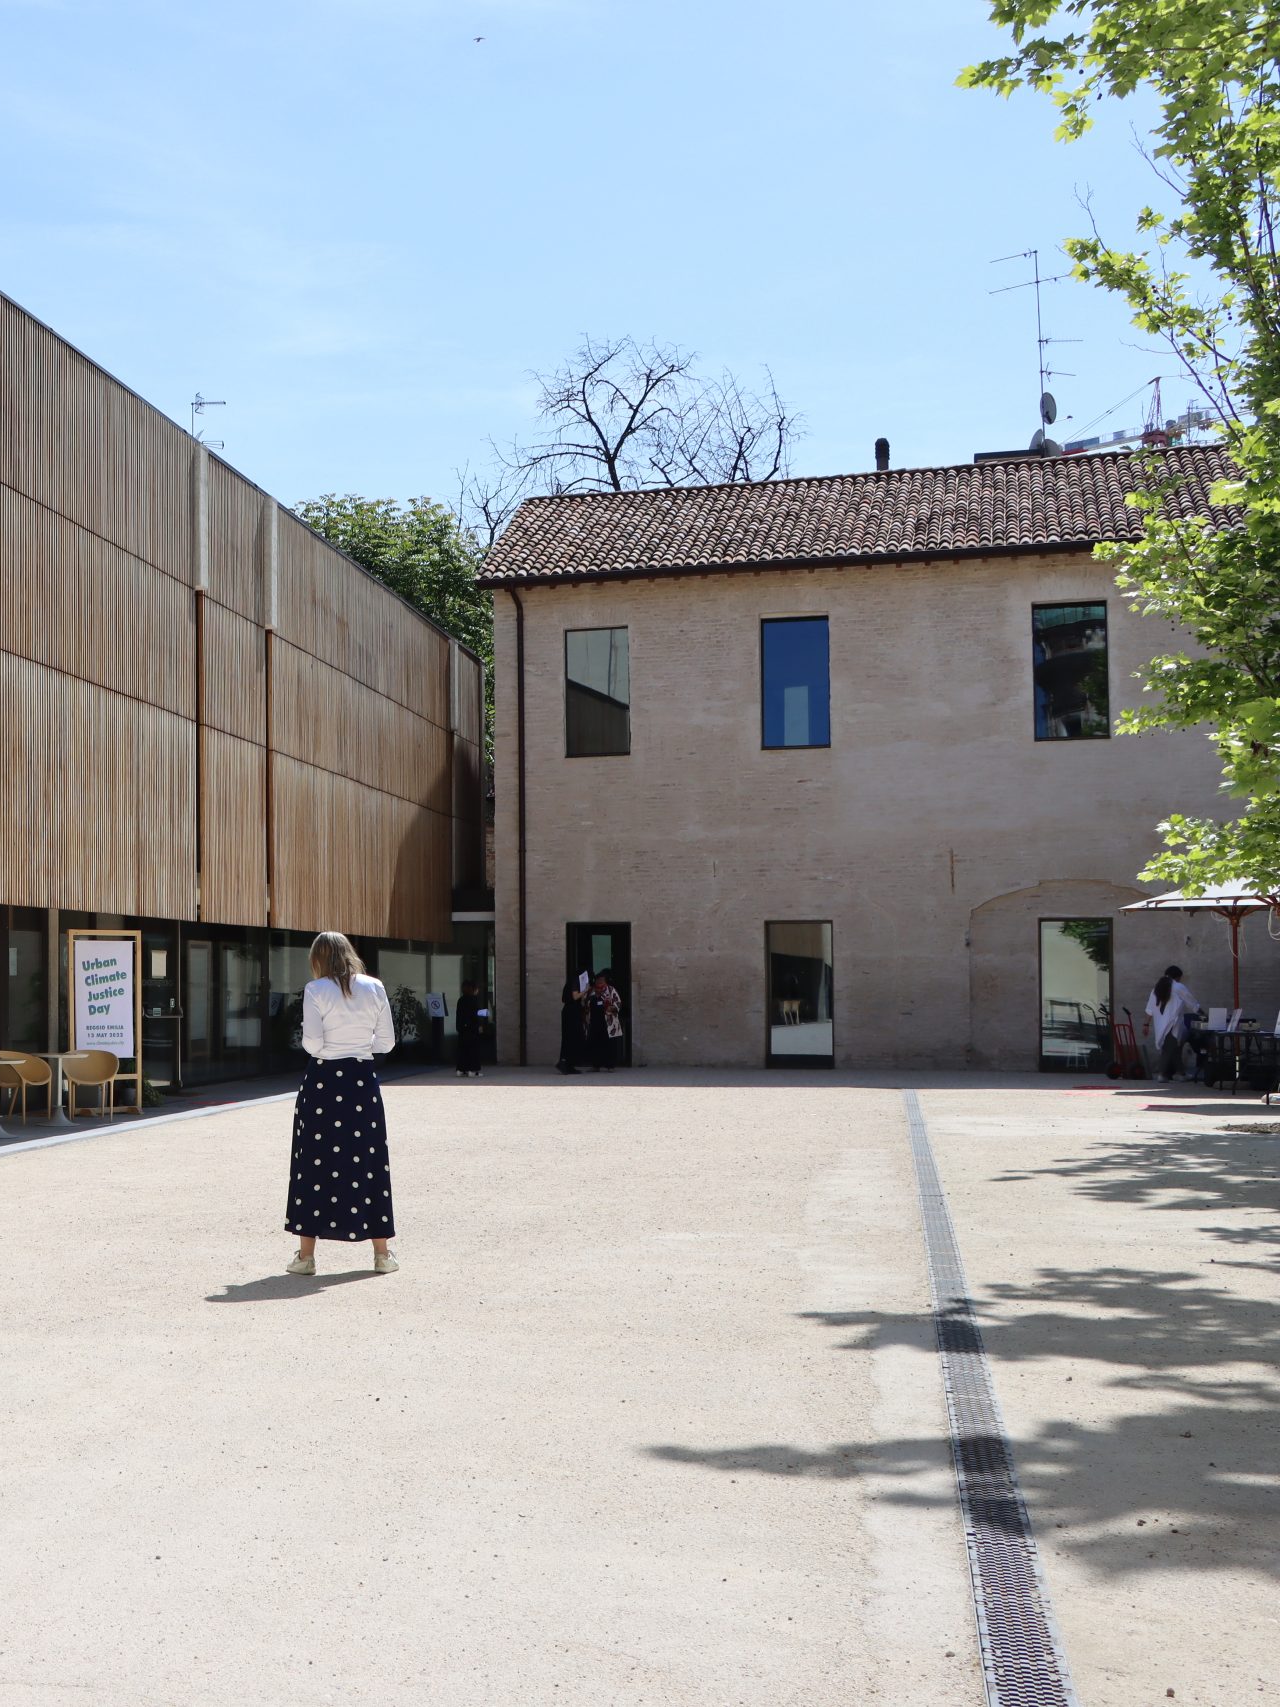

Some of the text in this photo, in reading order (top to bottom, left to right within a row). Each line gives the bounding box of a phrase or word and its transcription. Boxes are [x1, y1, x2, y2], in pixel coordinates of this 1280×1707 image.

[82, 957, 117, 972] Urban
[84, 970, 127, 987] Climate
[87, 986, 125, 1002] Justice
[88, 1003, 111, 1016] Day
